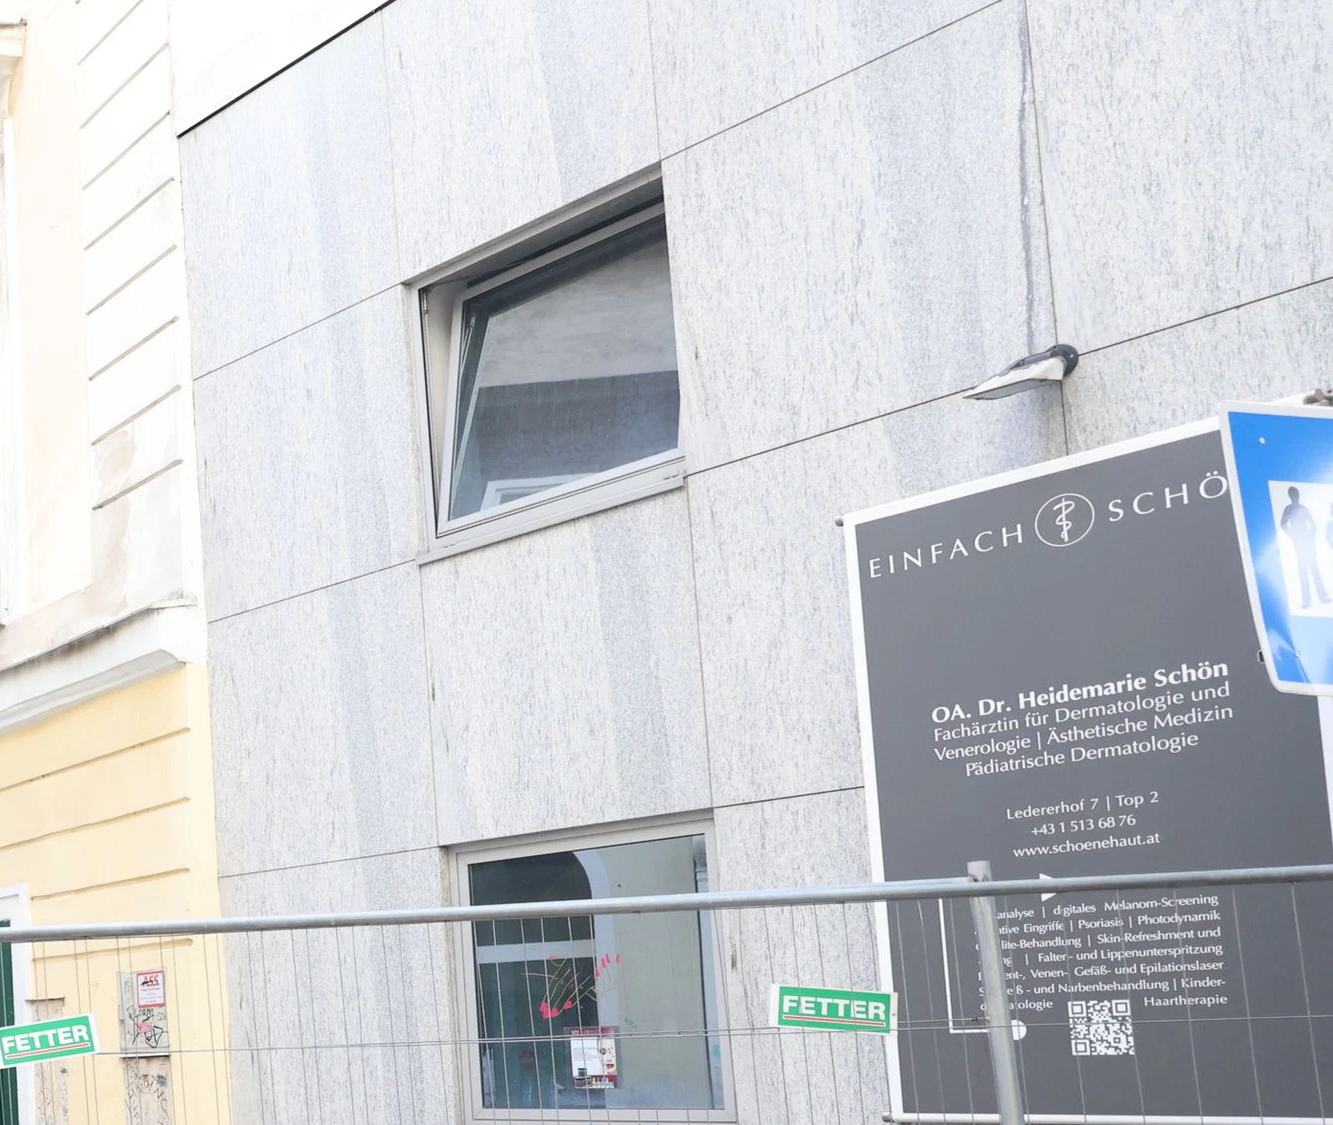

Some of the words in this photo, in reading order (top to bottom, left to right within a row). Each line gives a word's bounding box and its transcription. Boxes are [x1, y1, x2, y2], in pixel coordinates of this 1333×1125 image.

[868, 522, 1024, 579] EINFACH
[1107, 470, 1228, 523] SCHÖ
[931, 702, 971, 725] OA.
[978, 695, 1011, 716] Dr.
[1018, 672, 1147, 710] Heidemarie
[1153, 659, 1229, 688] Schön
[934, 715, 1019, 741] Fachärztin
[1024, 709, 1049, 728] für
[1055, 690, 1184, 725] Dermatologie
[1190, 681, 1230, 702] und
[934, 734, 1031, 763] Venerologie
[1046, 717, 1148, 746] Ästhetische
[1153, 704, 1233, 731] Medizin
[965, 750, 1066, 778] Pädiatrische
[1071, 732, 1199, 765] Dermatologie
[1006, 797, 1085, 820] Ledererhof
[1090, 798, 1099, 810] 7
[1115, 792, 1144, 809] Top
[1149, 791, 1159, 804] 2
[1031, 821, 1055, 837] +43
[1069, 818, 1094, 833] 513
[1099, 815, 1116, 829] 68
[1119, 813, 1137, 827] 76
[1013, 833, 1161, 858] www.schoenehaut.at
[996, 907, 1035, 921] analyse
[1053, 903, 1097, 918] dgitales
[1077, 917, 1124, 930] Psoriasis
[1137, 910, 1221, 926] Photodynamik
[1197, 926, 1221, 938] und
[1076, 949, 1098, 961] und
[1114, 962, 1137, 974] und
[1140, 960, 1224, 975] Epilationslaser
[1033, 983, 1055, 994] und
[1180, 976, 1227, 988] Kinder-
[782, 995, 886, 1020] FETTER
[1144, 994, 1228, 1010] Haartherapie
[0, 1024, 90, 1054] FETTER
